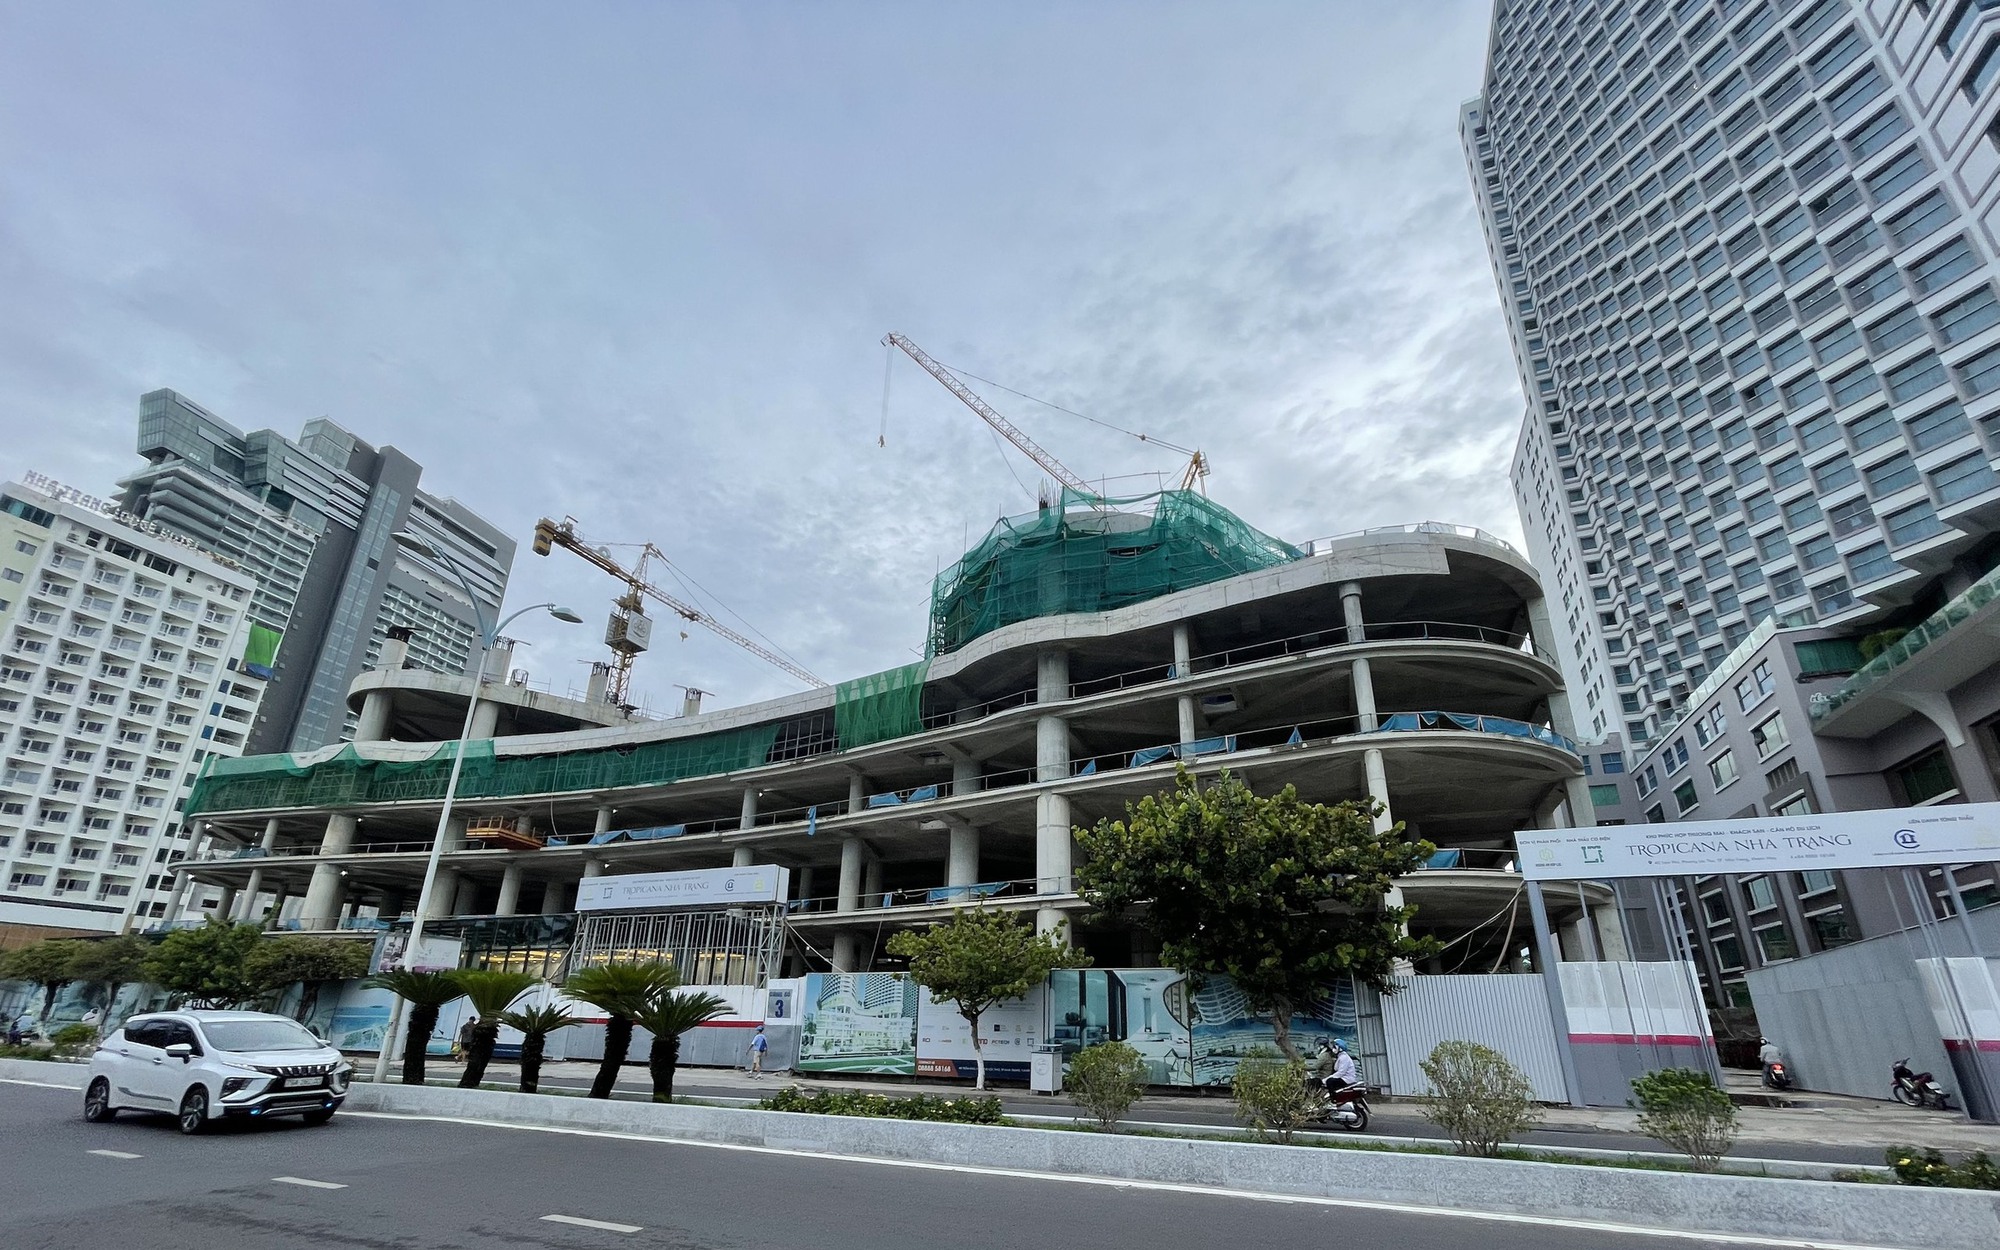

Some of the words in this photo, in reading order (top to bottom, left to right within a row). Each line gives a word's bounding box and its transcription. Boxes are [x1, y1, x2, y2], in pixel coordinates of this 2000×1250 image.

[62, 485, 112, 514] TRANG
[1625, 841, 1728, 858] TROPICANA
[1734, 838, 1778, 851] NHA
[1782, 833, 1852, 851] TRANG
[623, 885, 662, 895] TROPICANA
[684, 882, 709, 892] TRANG
[775, 999, 784, 1018] 3
